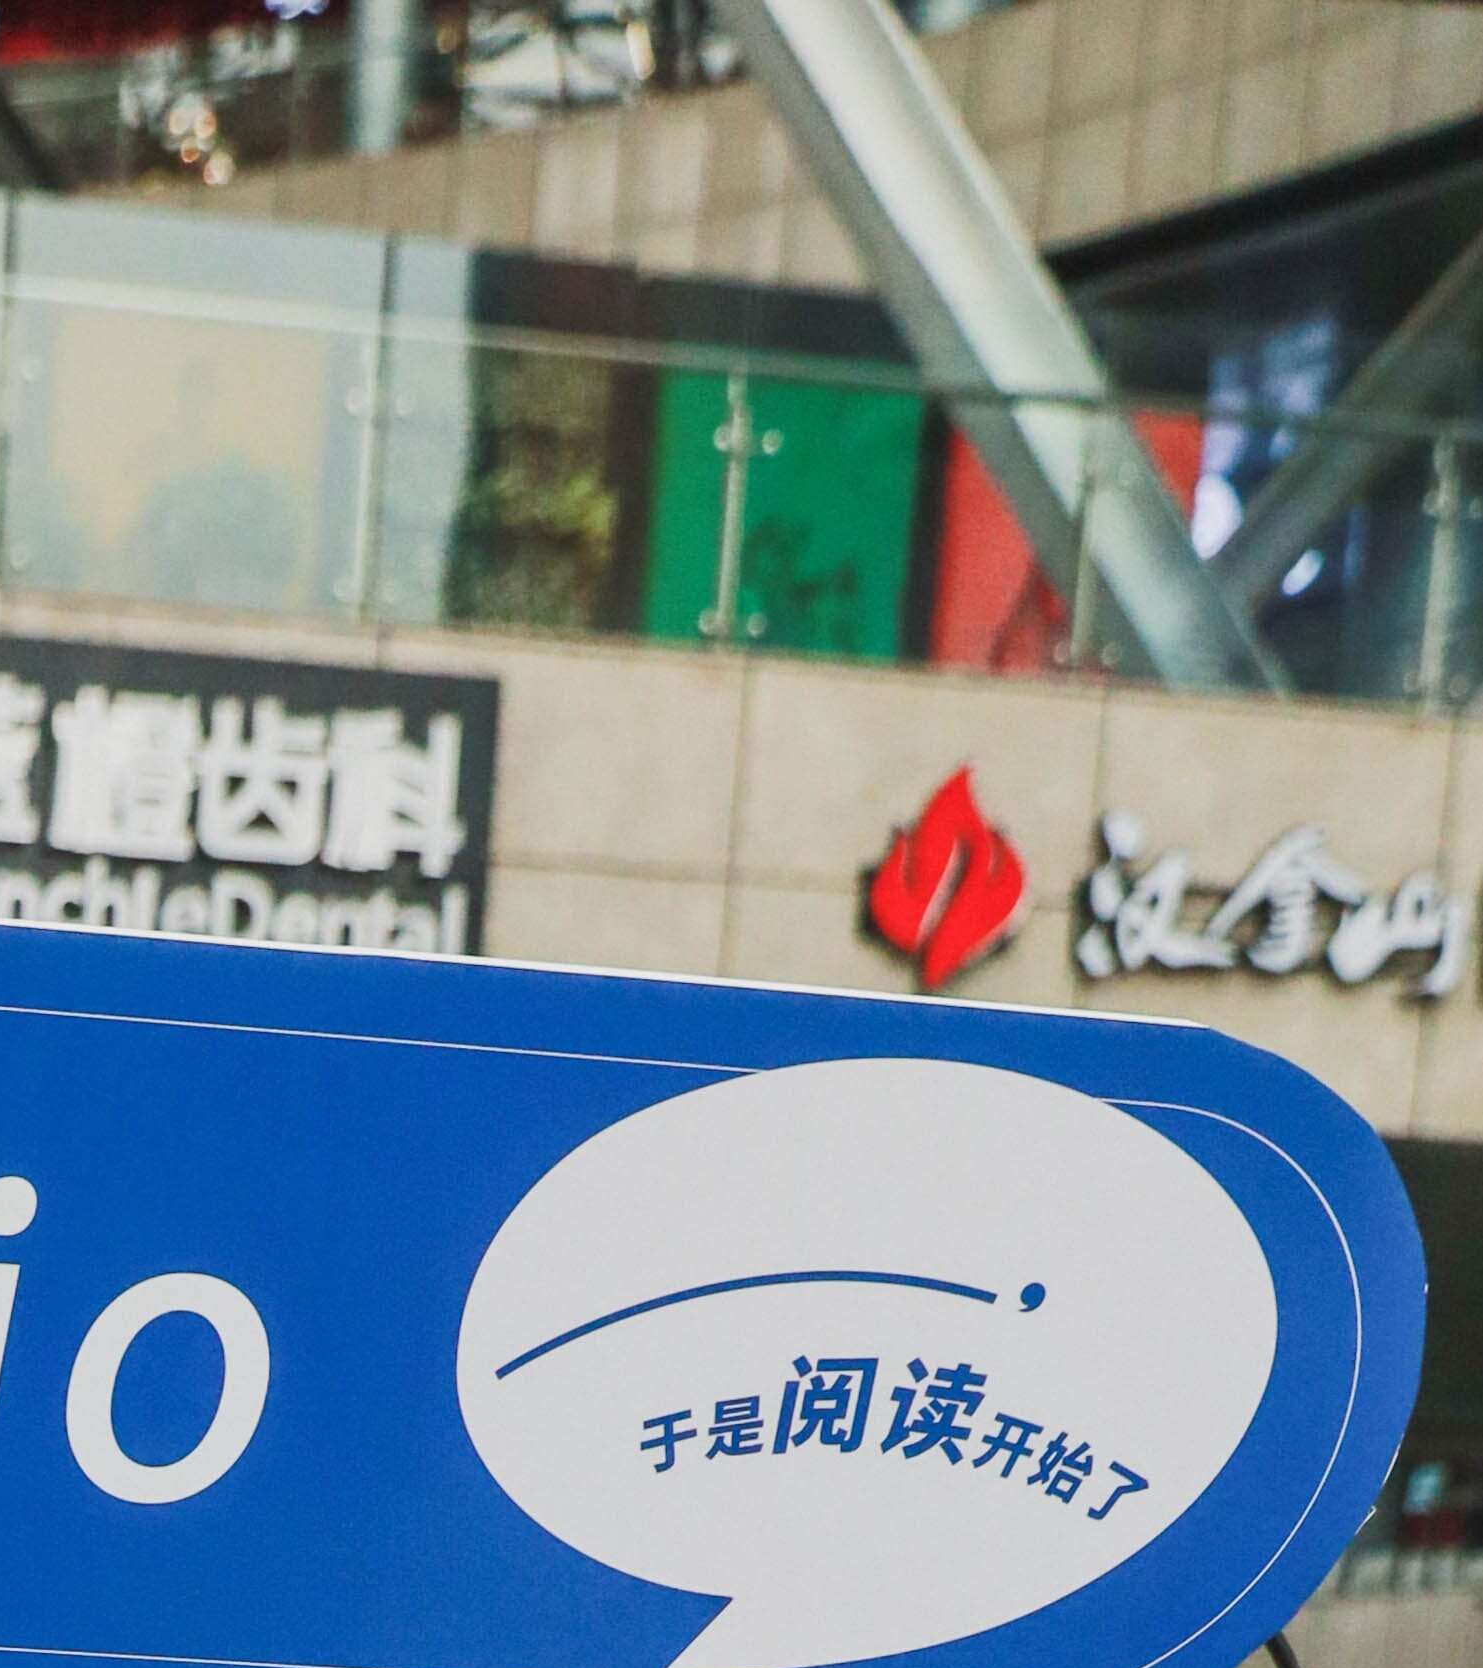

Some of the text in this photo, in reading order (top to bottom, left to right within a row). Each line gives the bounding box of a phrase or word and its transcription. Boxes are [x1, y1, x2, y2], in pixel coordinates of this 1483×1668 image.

[639, 1355, 1149, 1521] 于是阅读开始了
